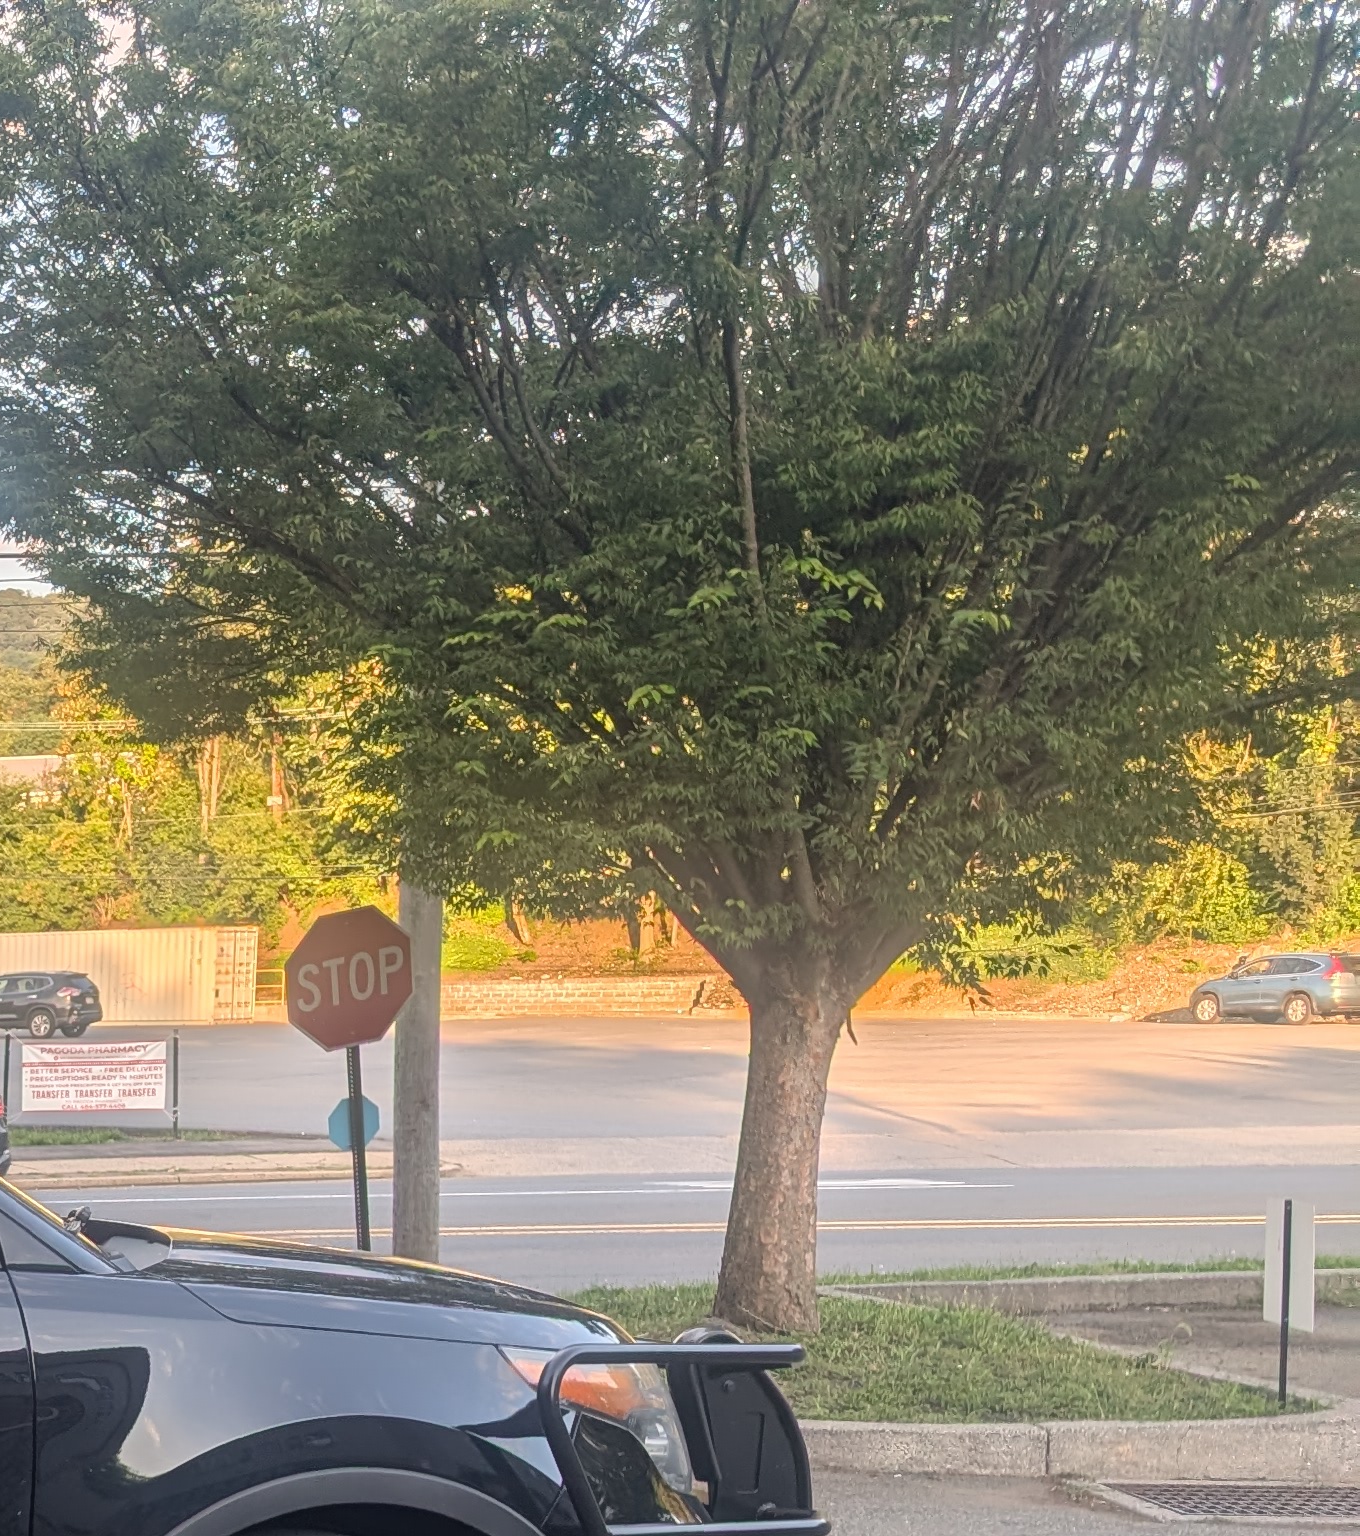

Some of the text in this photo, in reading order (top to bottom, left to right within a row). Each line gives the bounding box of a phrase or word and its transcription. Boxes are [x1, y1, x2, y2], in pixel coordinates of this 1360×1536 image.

[296, 945, 405, 1013] STOP
[40, 1044, 149, 1055] PAGODA PHARMACY
[30, 1074, 90, 1082] PRESCRIPTIONS
[32, 1088, 157, 1099] TRANSFER TRANSFER TRANSFER
